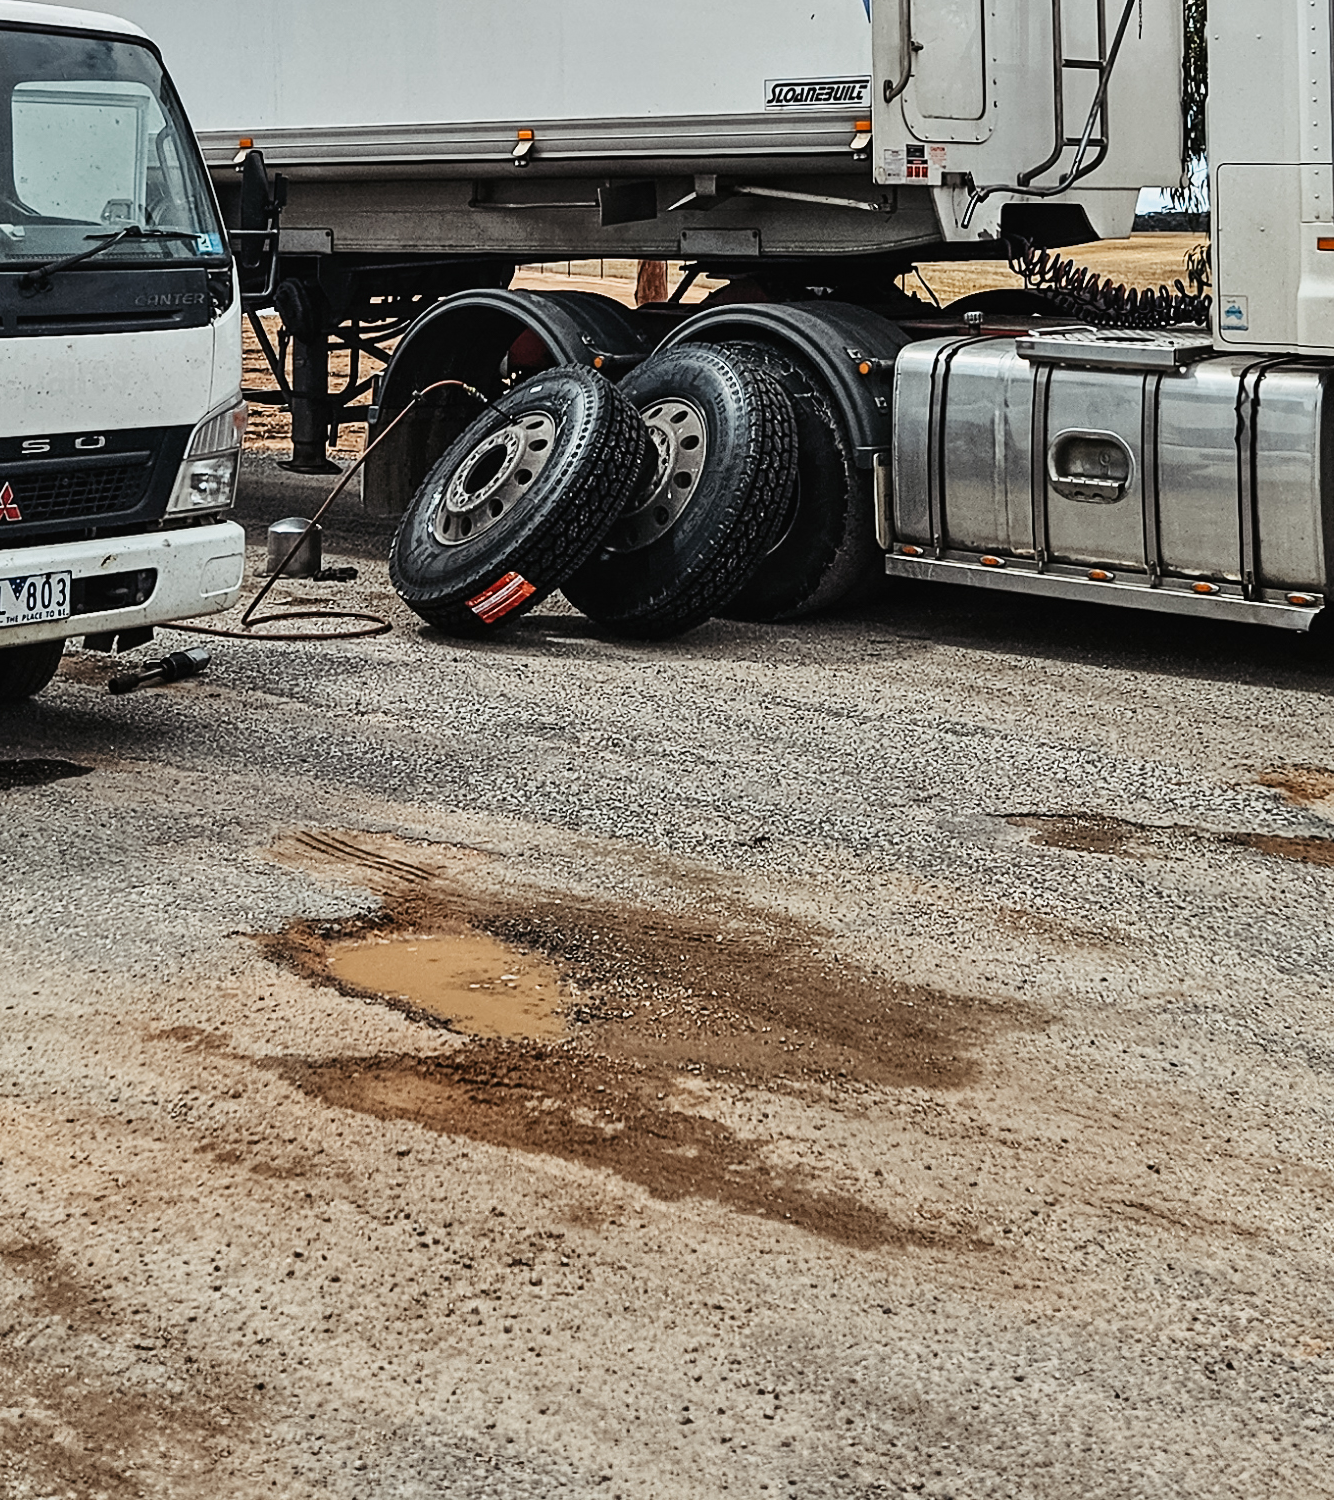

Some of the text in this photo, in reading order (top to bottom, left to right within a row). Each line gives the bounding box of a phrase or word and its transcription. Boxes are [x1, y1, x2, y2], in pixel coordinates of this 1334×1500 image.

[135, 293, 205, 306] CANTER
[26, 577, 67, 611] 803
[6, 615, 19, 623] THE
[21, 612, 43, 621] PLACE
[45, 610, 55, 618] TO
